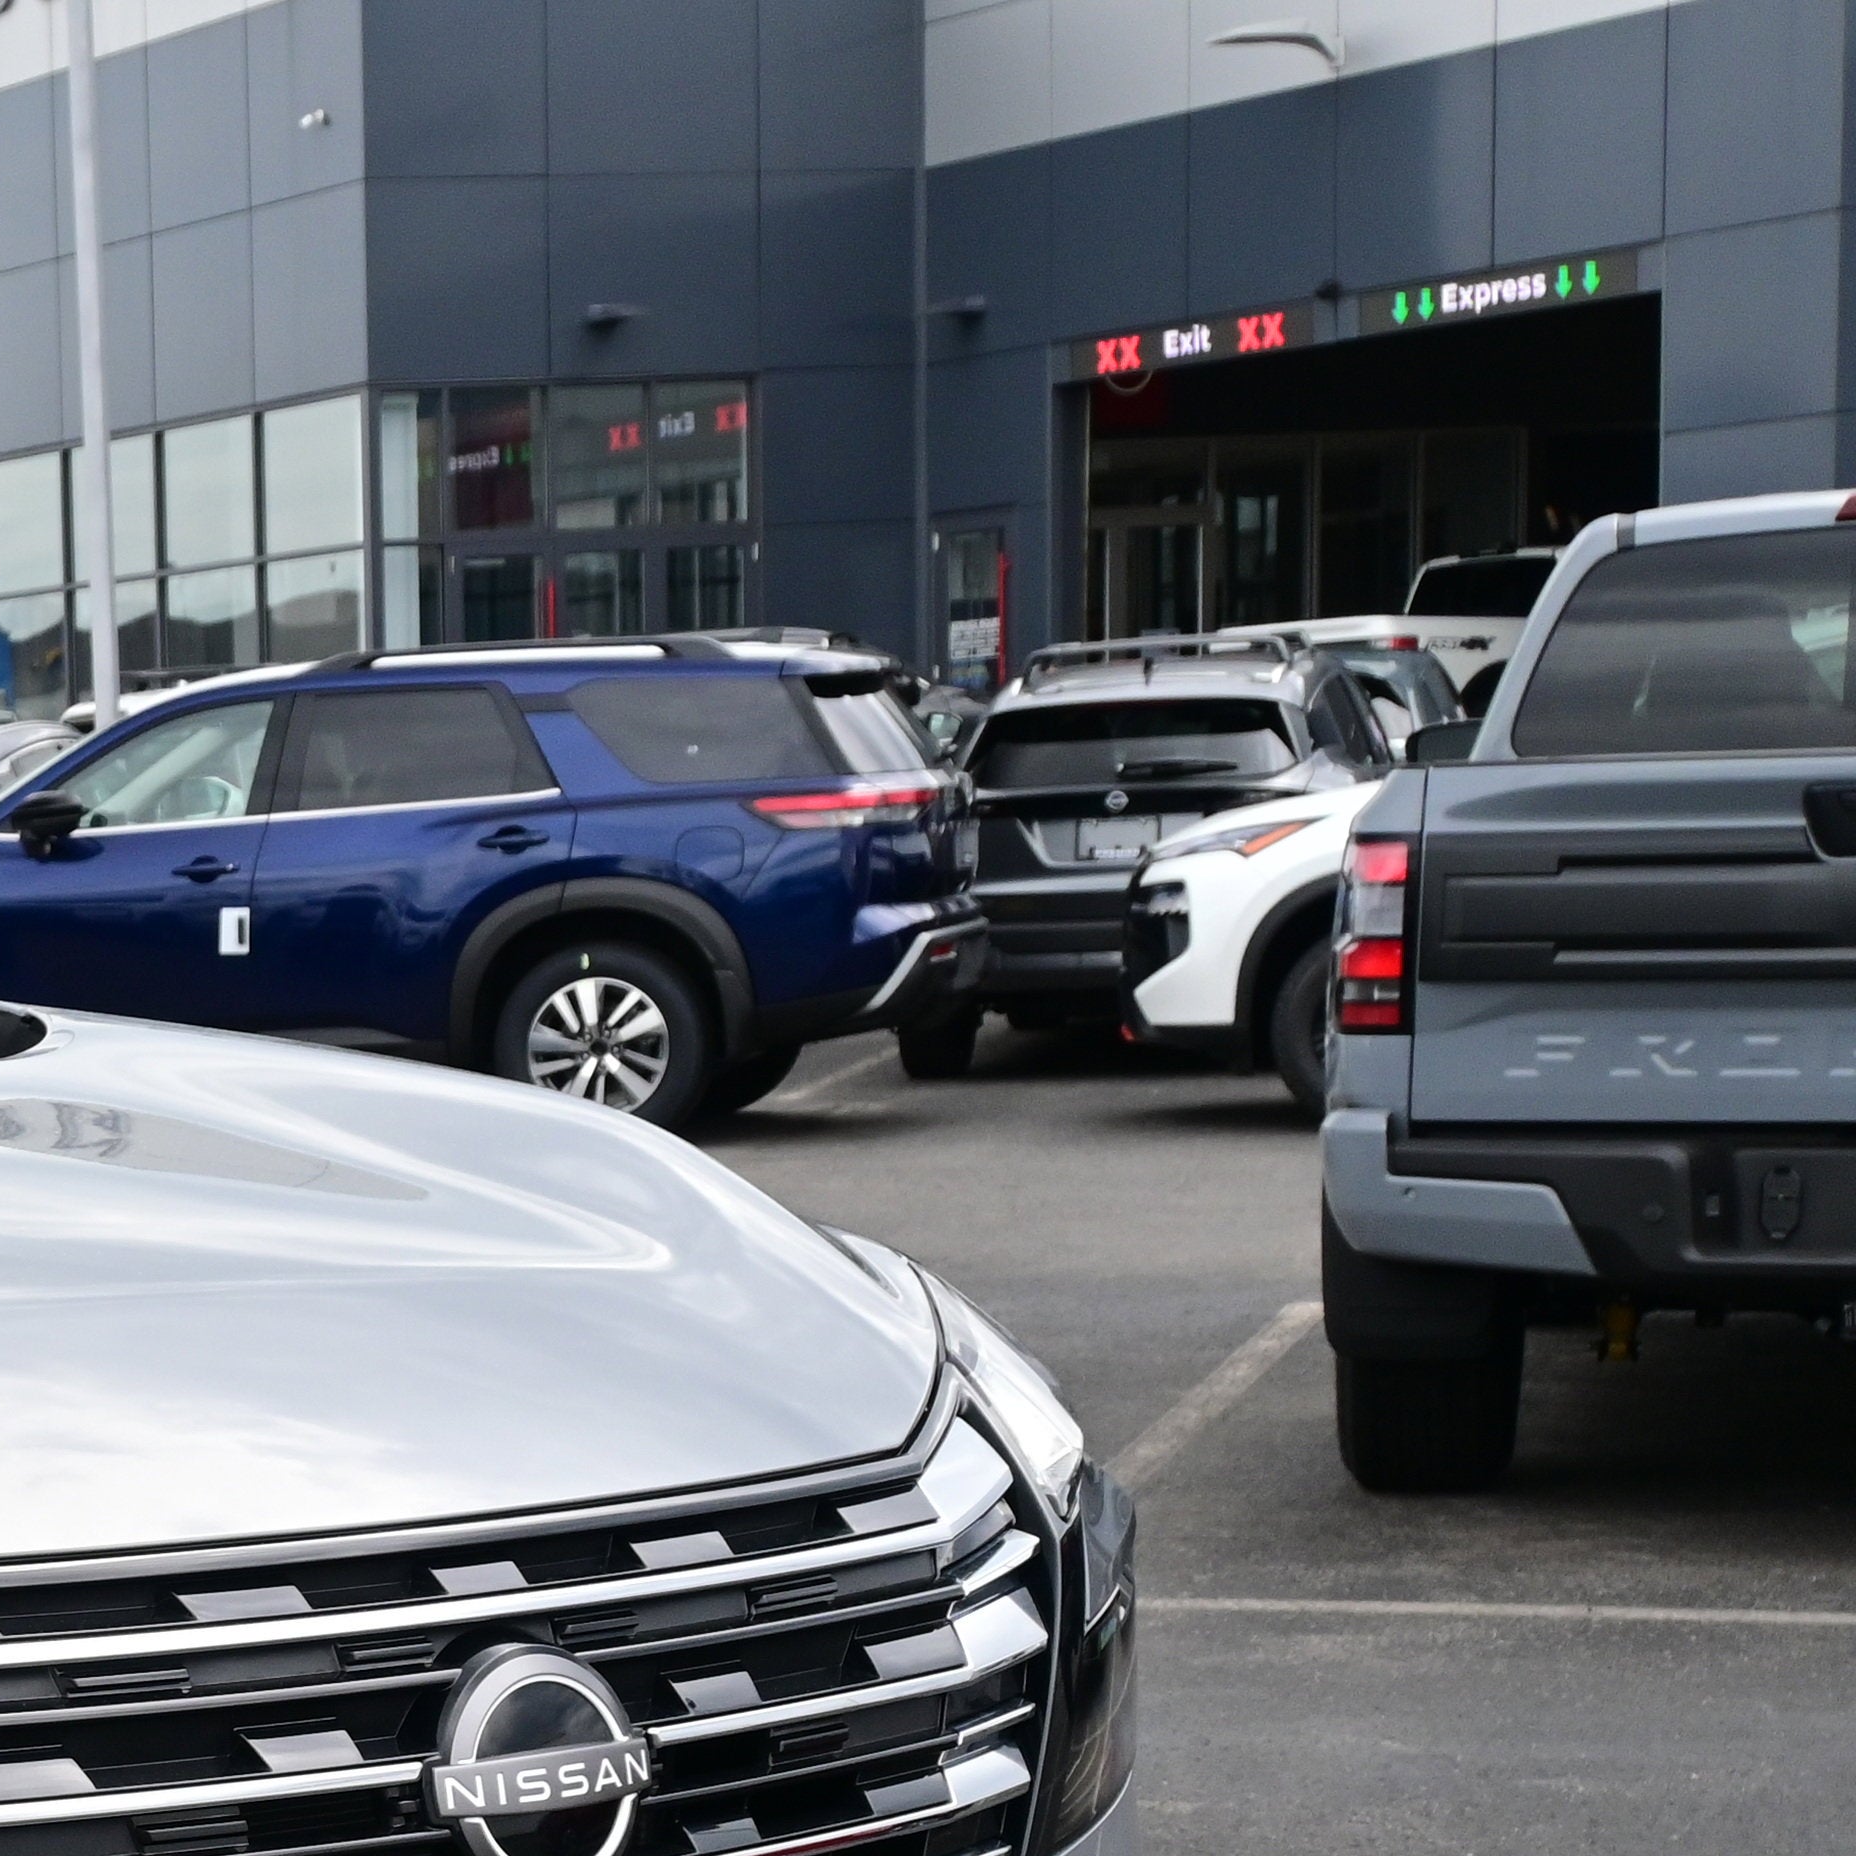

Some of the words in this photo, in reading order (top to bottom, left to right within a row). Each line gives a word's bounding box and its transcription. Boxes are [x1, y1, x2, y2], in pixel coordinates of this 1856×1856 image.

[1441, 271, 1547, 315] Express
[1163, 323, 1212, 359] Exit
[444, 1749, 649, 1810] NISSAN
